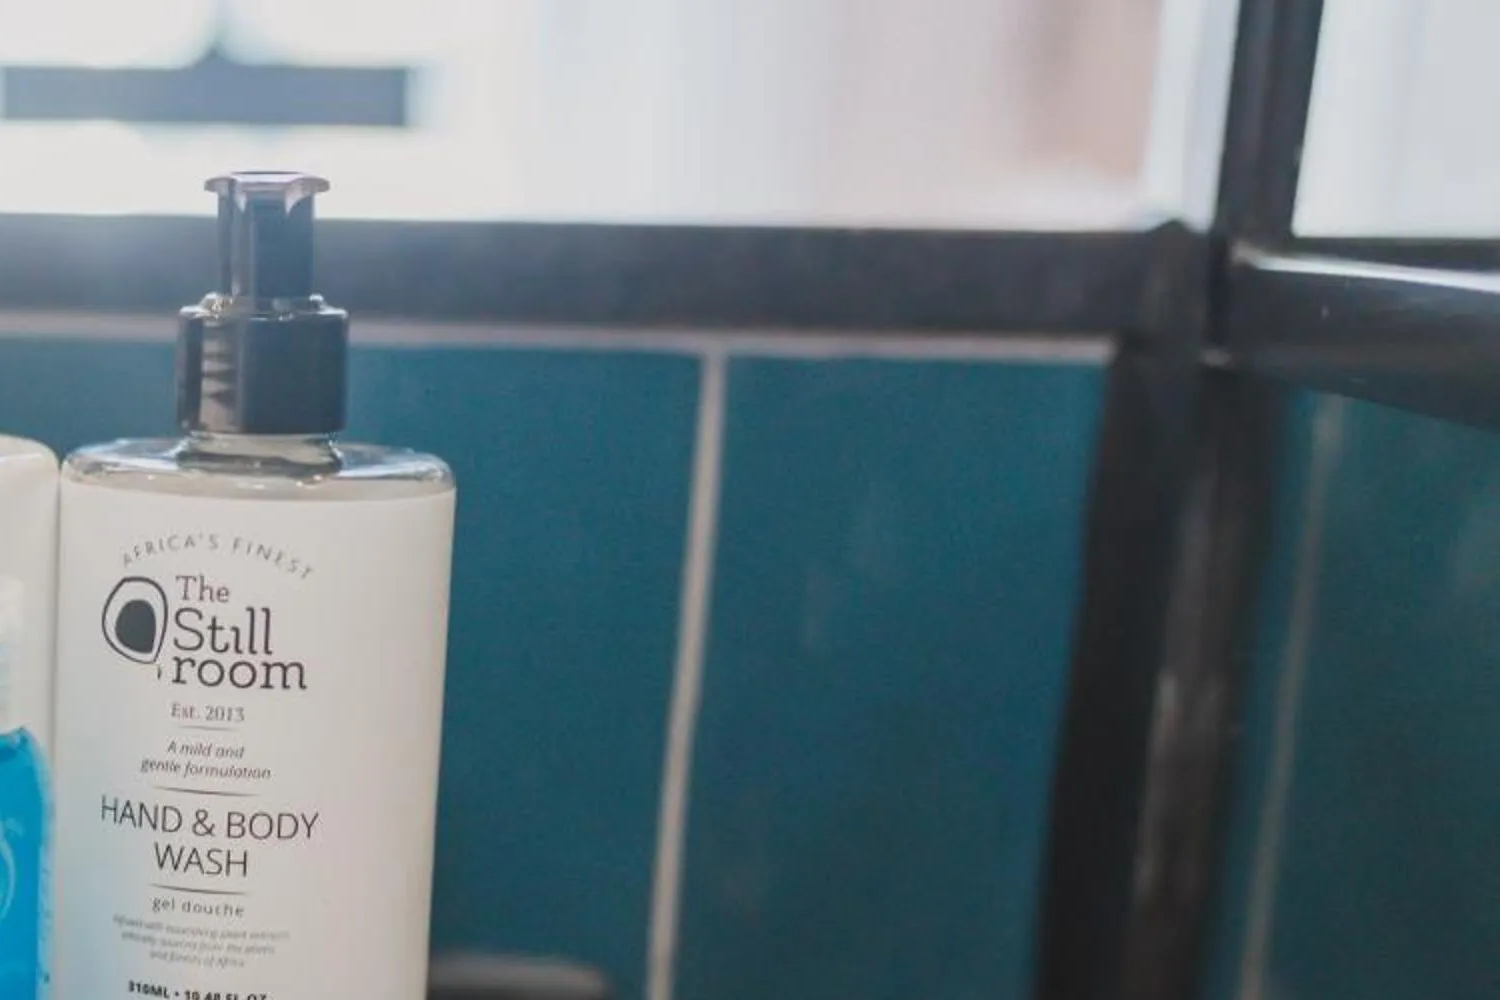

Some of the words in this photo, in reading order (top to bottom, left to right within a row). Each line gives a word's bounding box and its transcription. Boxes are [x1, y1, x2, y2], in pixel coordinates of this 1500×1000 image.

[122, 533, 219, 568] AFRICA'S
[233, 537, 313, 580] FINEST
[176, 574, 230, 603] The
[173, 606, 273, 655] Still
[171, 655, 307, 690] room
[170, 702, 199, 721] Est.
[204, 705, 245, 723] 2013
[167, 740, 177, 753] A
[180, 743, 213, 757] mild
[216, 746, 245, 759] and
[140, 758, 180, 773] gentle
[184, 761, 271, 779] formulation
[101, 795, 183, 834] HAND
[192, 809, 215, 837] &
[227, 811, 319, 840] BODY
[155, 842, 248, 877] WASH
[152, 897, 176, 913] gel
[182, 899, 245, 918] douche
[128, 980, 170, 999] 310ML
